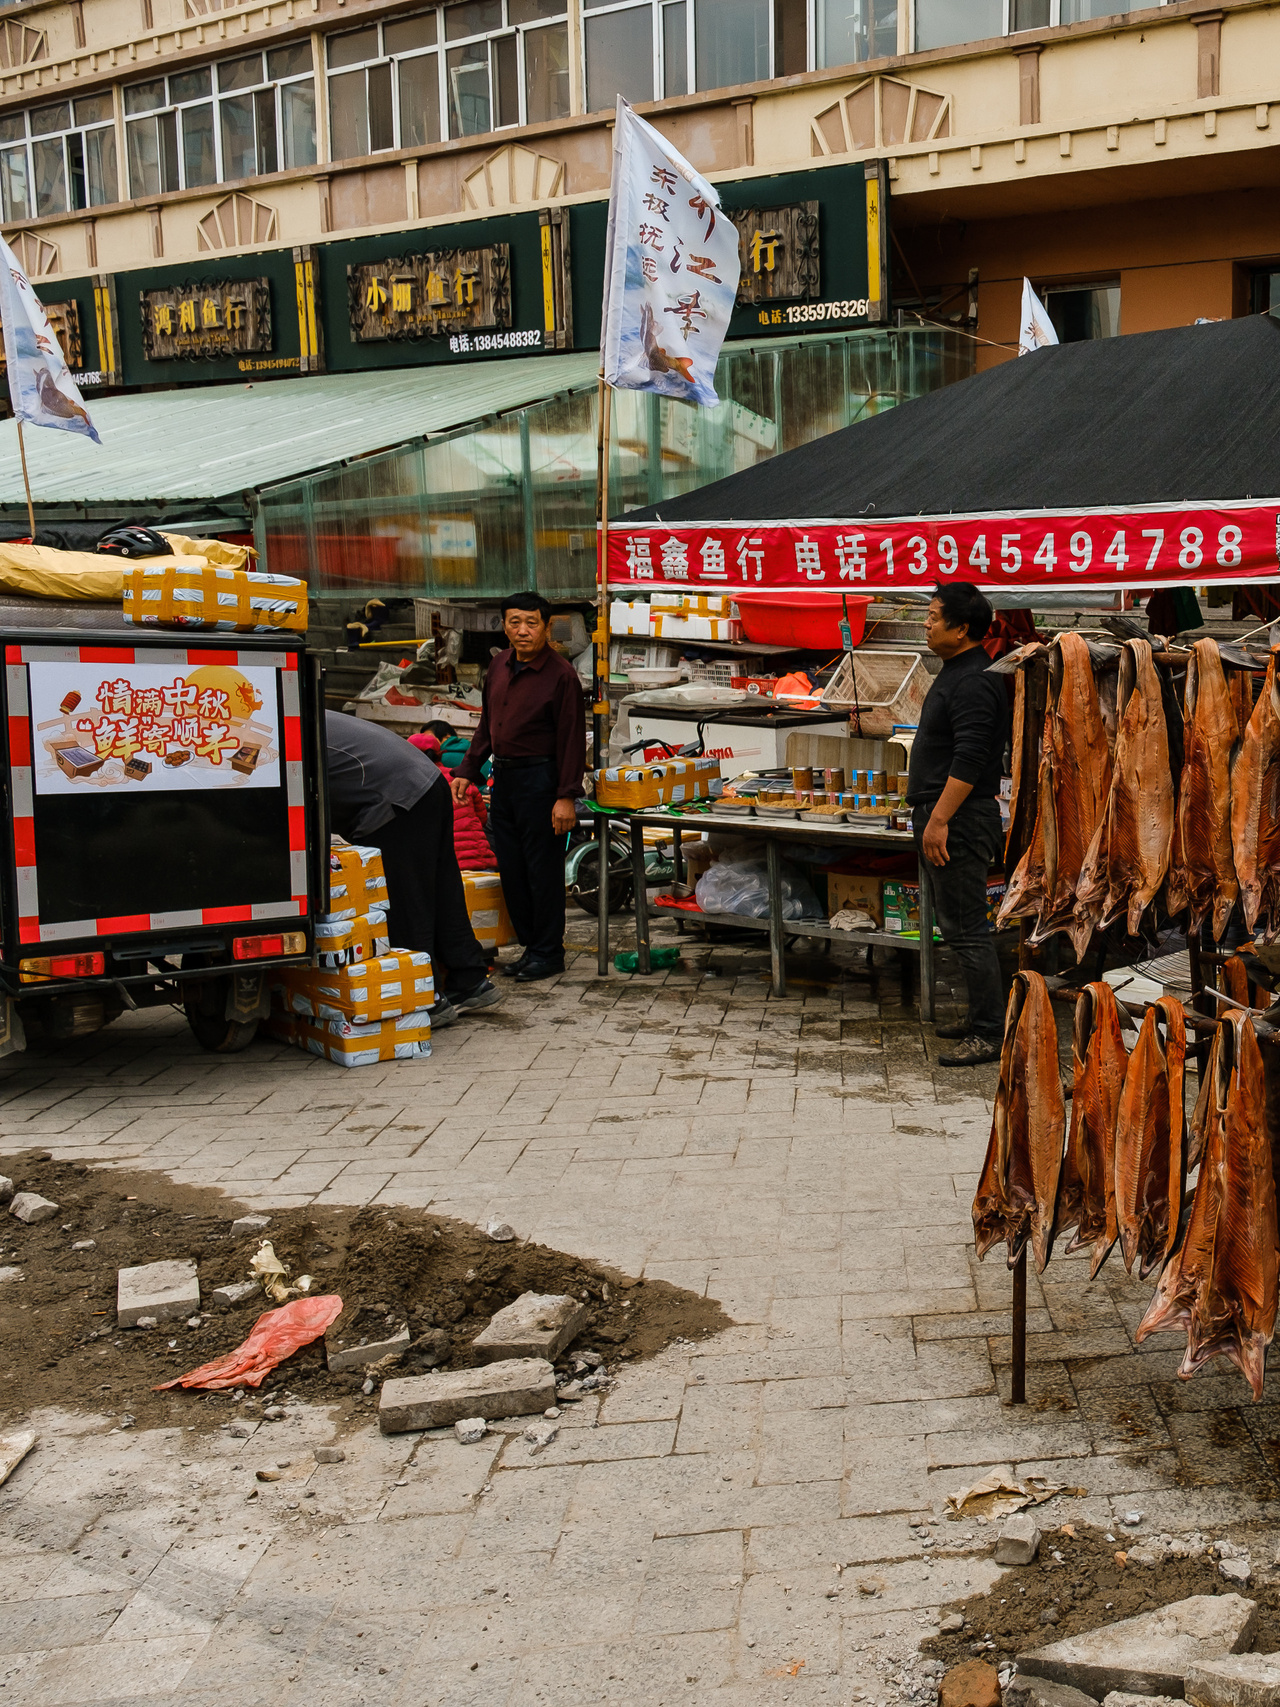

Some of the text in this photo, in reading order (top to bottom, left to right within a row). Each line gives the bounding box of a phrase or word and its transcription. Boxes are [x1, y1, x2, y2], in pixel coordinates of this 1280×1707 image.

[626, 535, 765, 582] 福鑫鱼行
[97, 677, 231, 719] 情满中秋
